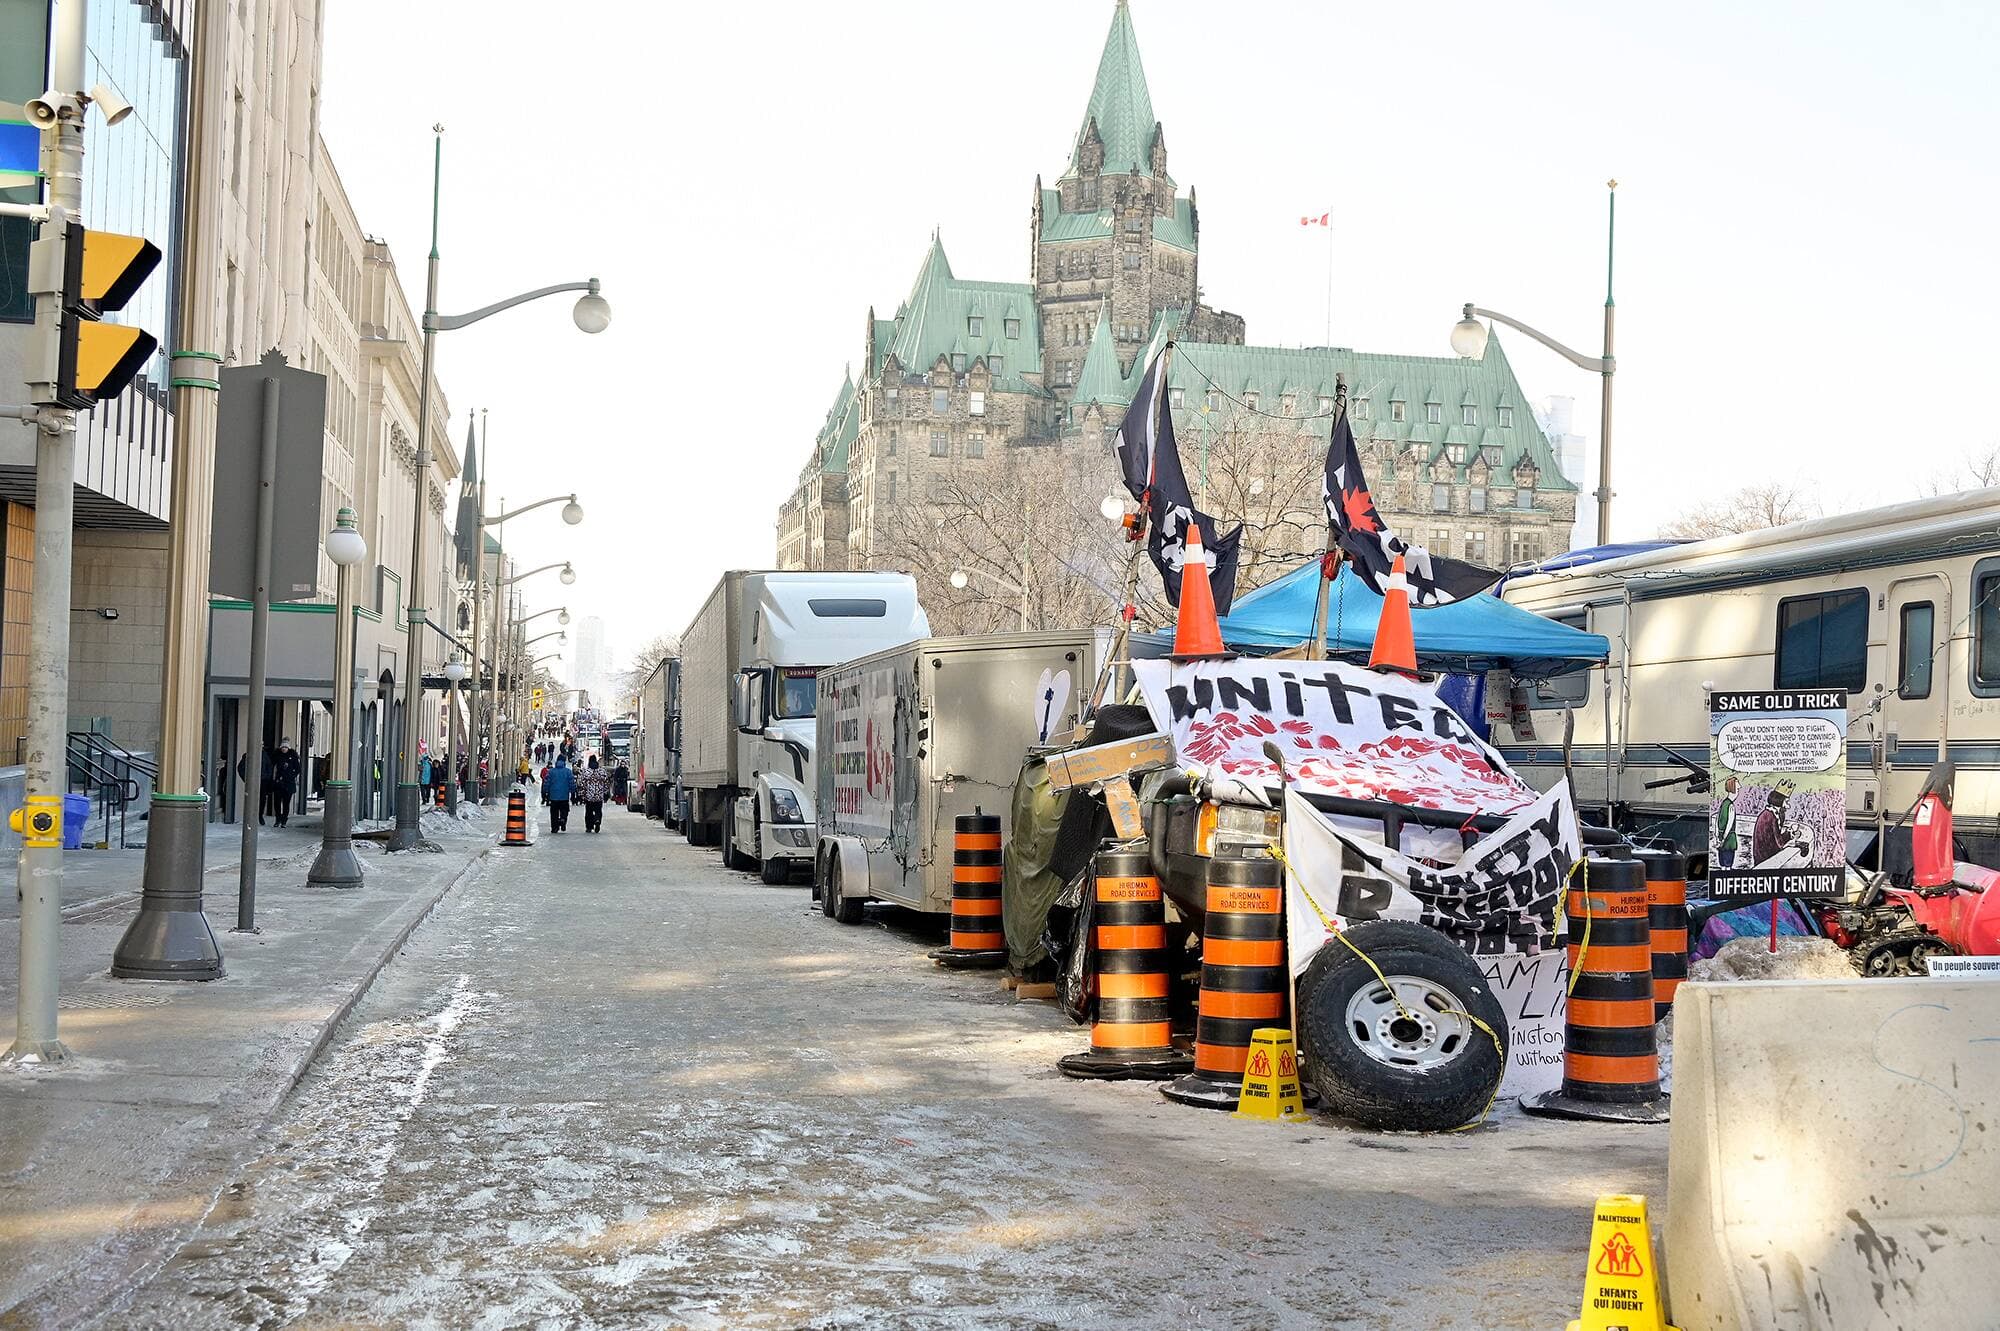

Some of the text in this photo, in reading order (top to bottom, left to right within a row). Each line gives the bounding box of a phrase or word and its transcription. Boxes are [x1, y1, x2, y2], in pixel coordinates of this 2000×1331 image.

[1719, 693, 1840, 710] SAME OLD TRICK
[1806, 733, 1836, 741] CONVINCE
[1715, 874, 1838, 895] DIFFERENT CENTURY
[1129, 889, 1156, 897] SERVICES
[1229, 892, 1261, 900] HURDMAN
[1220, 900, 1270, 909] ROAD SERVICES
[1610, 906, 1628, 914] ROAD
[1932, 961, 1942, 970] Un
[1944, 961, 1970, 971] peuple
[1599, 1287, 1638, 1299] ENFANTS
[1593, 1298, 1644, 1311] QUI JOUENT
